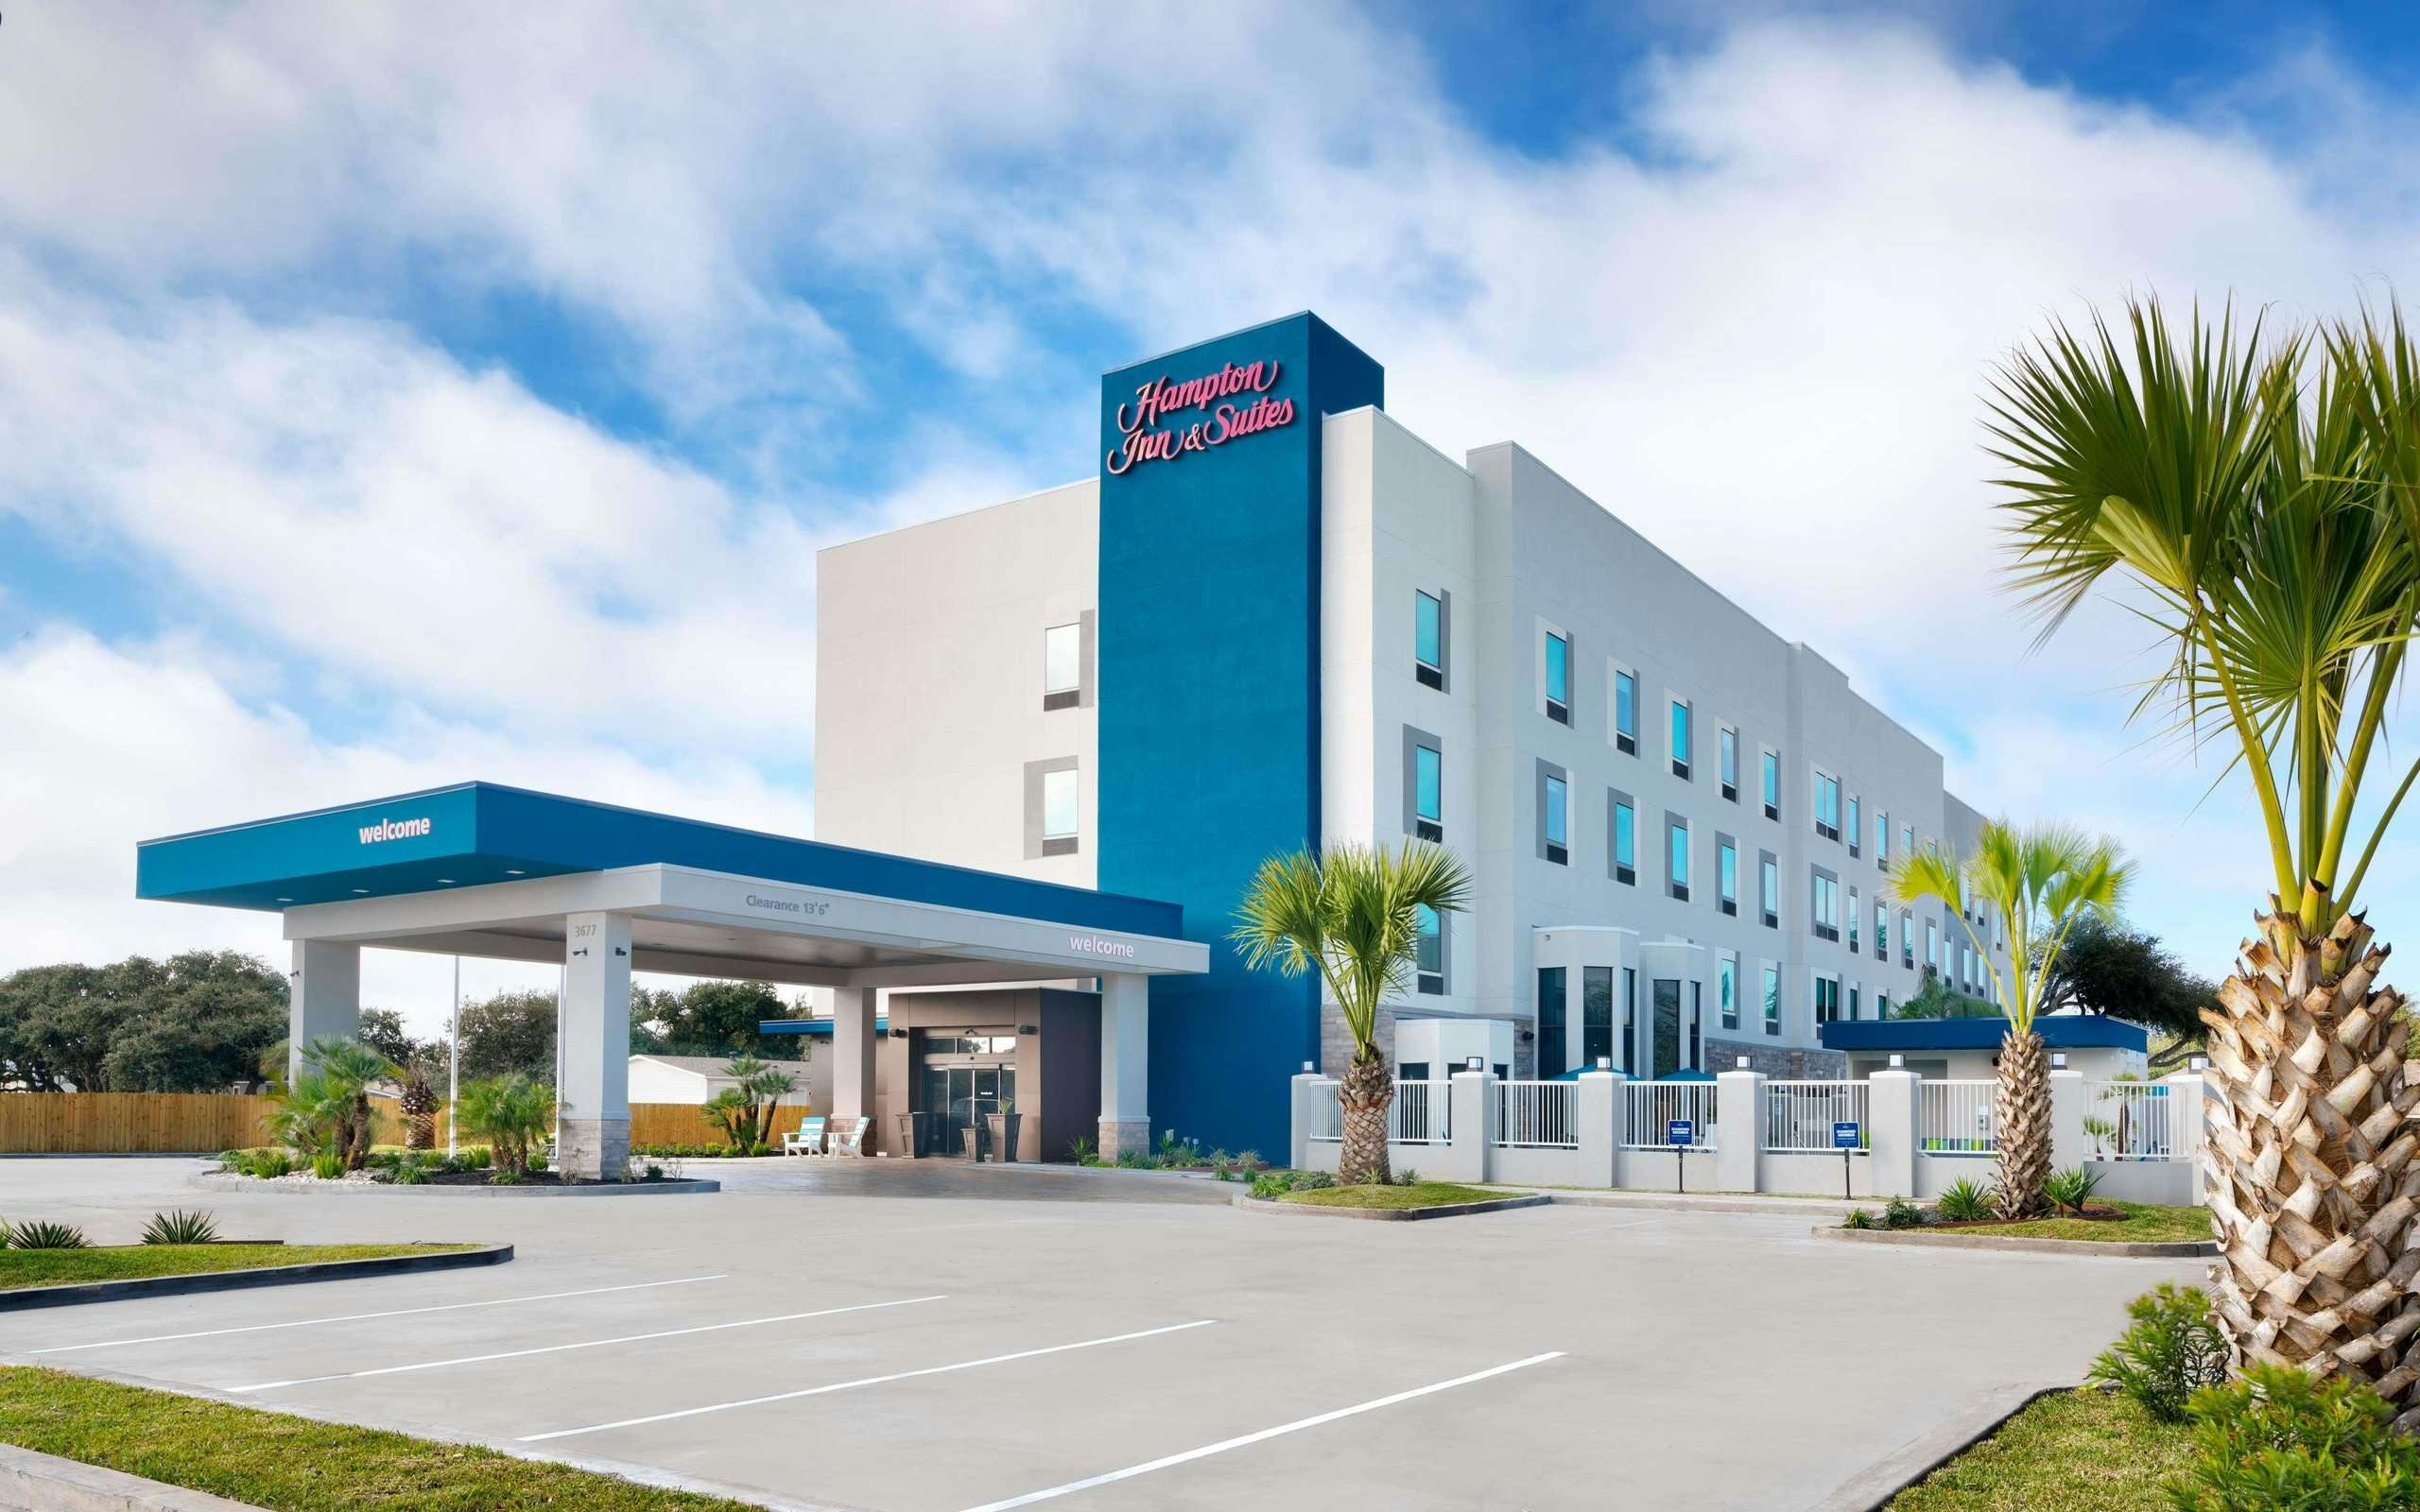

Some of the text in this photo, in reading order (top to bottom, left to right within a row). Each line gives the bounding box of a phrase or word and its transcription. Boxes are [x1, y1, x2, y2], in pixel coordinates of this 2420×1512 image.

[1117, 359, 1278, 434] Hampton
[1107, 397, 1294, 474] Inn & Suites
[359, 817, 430, 845] welcome
[746, 895, 800, 913] Clearance
[574, 924, 596, 938] 3677
[1069, 935, 1134, 958] welcome
